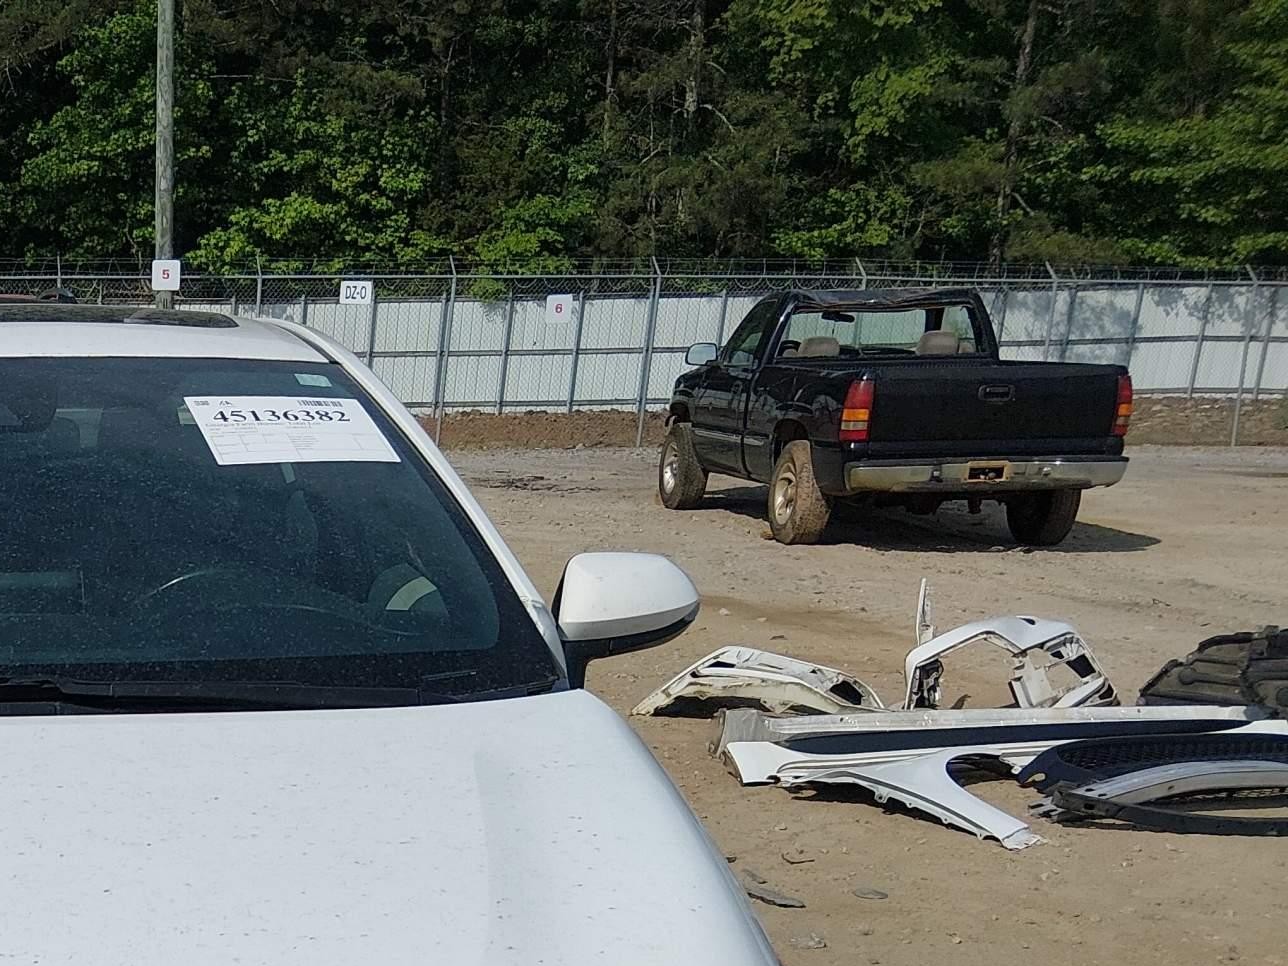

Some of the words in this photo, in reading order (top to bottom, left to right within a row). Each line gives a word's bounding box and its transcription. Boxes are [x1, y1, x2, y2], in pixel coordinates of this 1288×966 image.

[162, 269, 170, 280] 5
[555, 303, 563, 314] 6
[213, 409, 351, 423] 45136382
